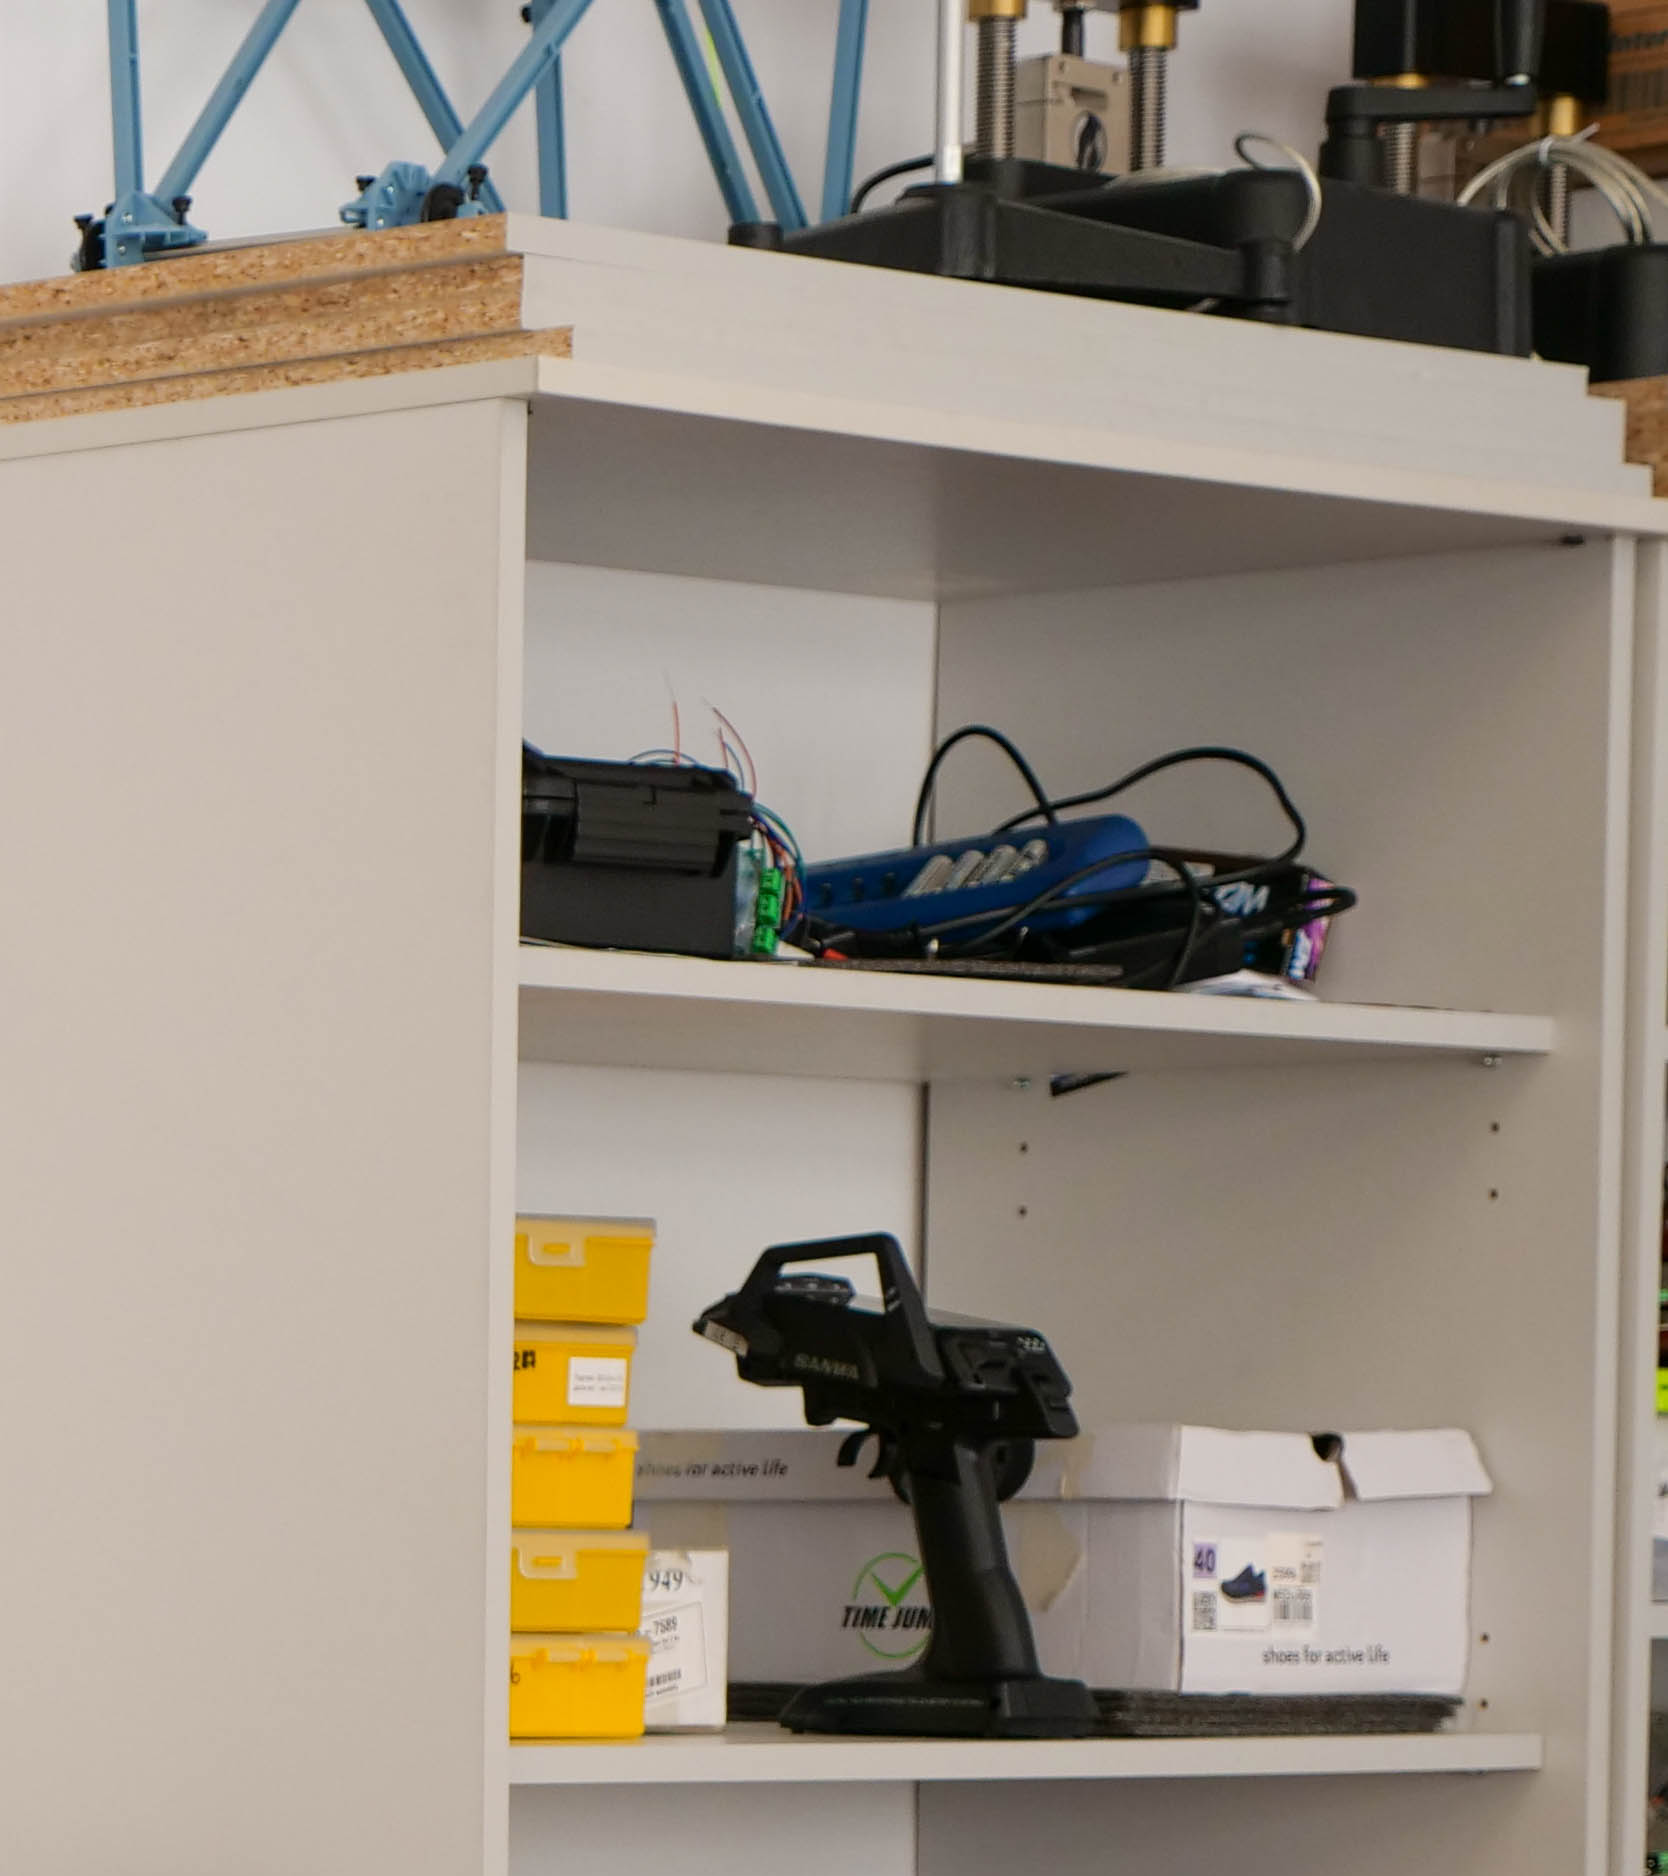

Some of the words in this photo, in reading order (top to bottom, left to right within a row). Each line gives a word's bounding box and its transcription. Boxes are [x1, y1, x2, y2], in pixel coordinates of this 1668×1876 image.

[711, 1461, 760, 1477] active
[762, 1458, 789, 1477] life
[1194, 1548, 1215, 1573] 40
[841, 1605, 891, 1630] TIME
[1262, 1646, 1300, 1665] shoes
